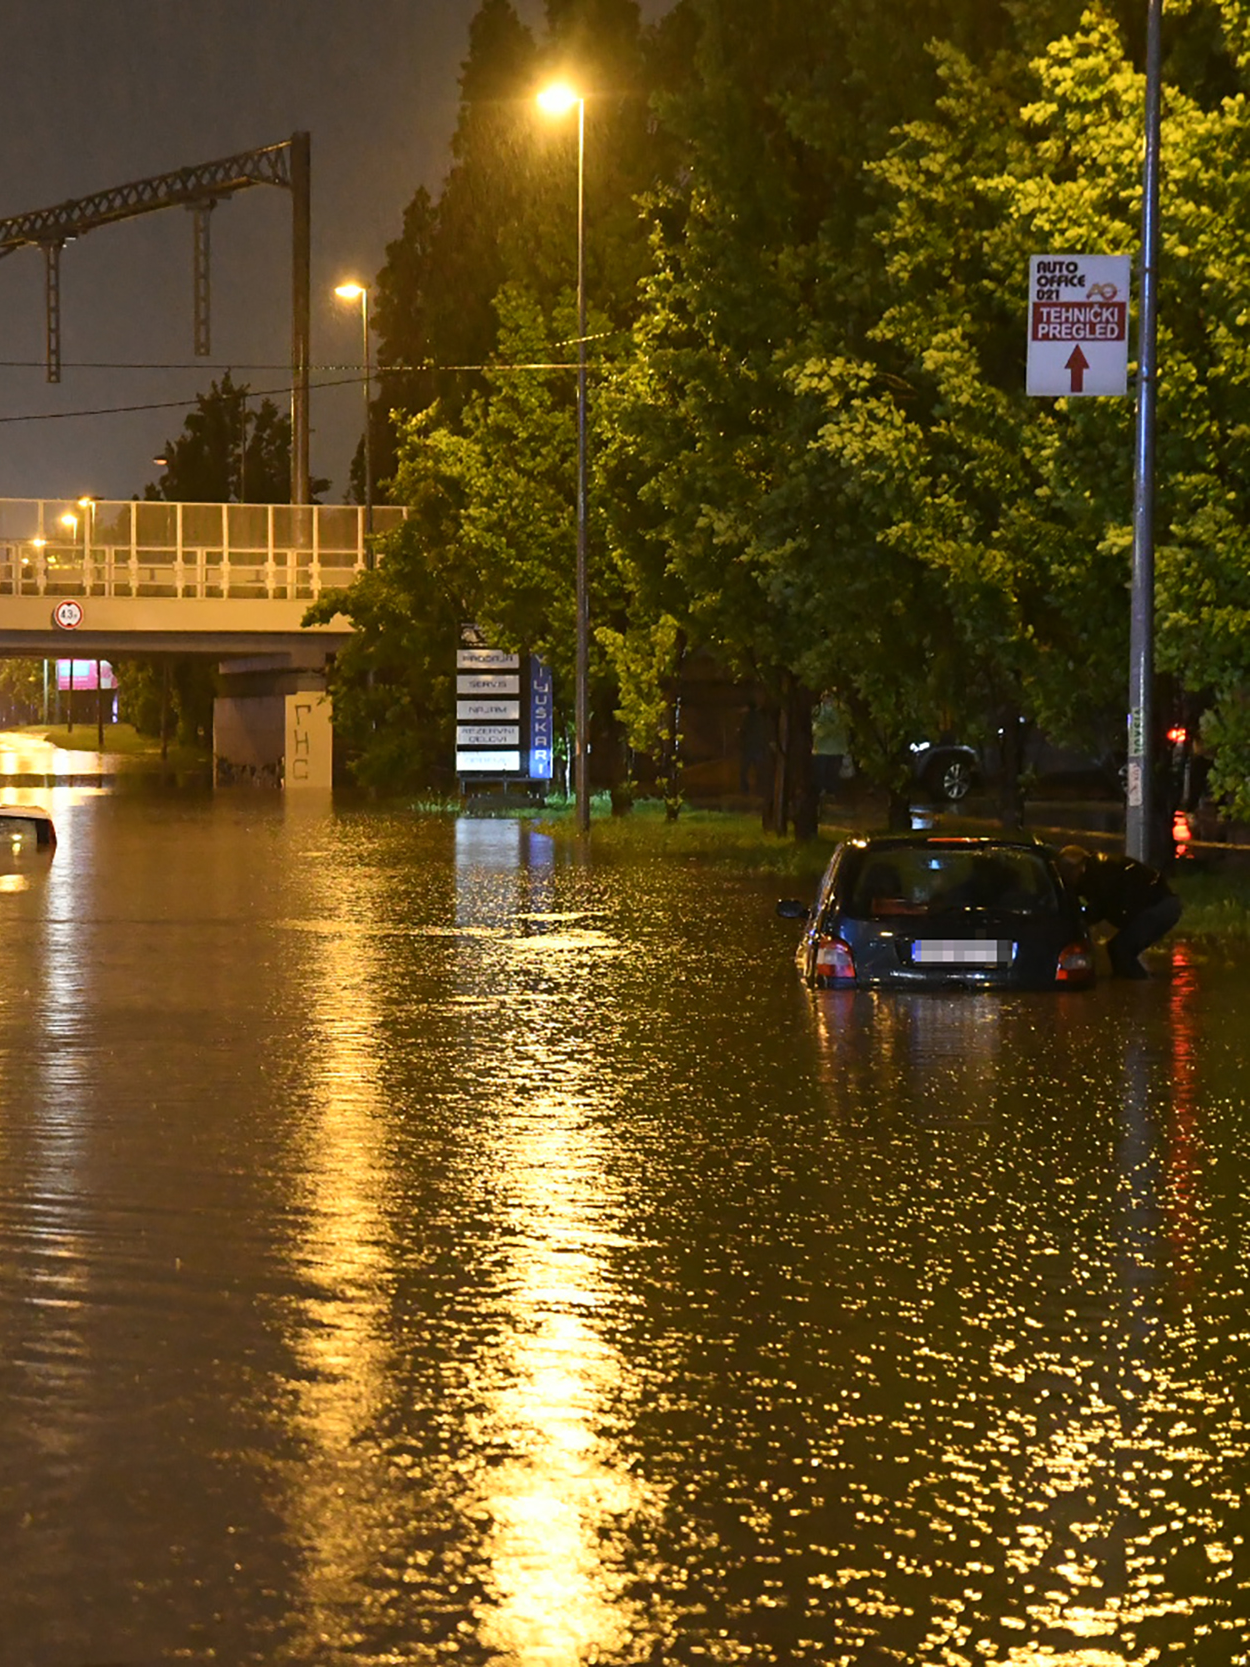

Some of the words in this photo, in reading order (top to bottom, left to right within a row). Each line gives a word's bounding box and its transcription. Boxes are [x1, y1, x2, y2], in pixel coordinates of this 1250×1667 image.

[1037, 261, 1078, 274] AUTO
[1037, 275, 1086, 287] OFFICE
[1037, 289, 1060, 301] 021
[1040, 305, 1118, 322] TEHNIČKI
[1038, 324, 1119, 338] PREGLED
